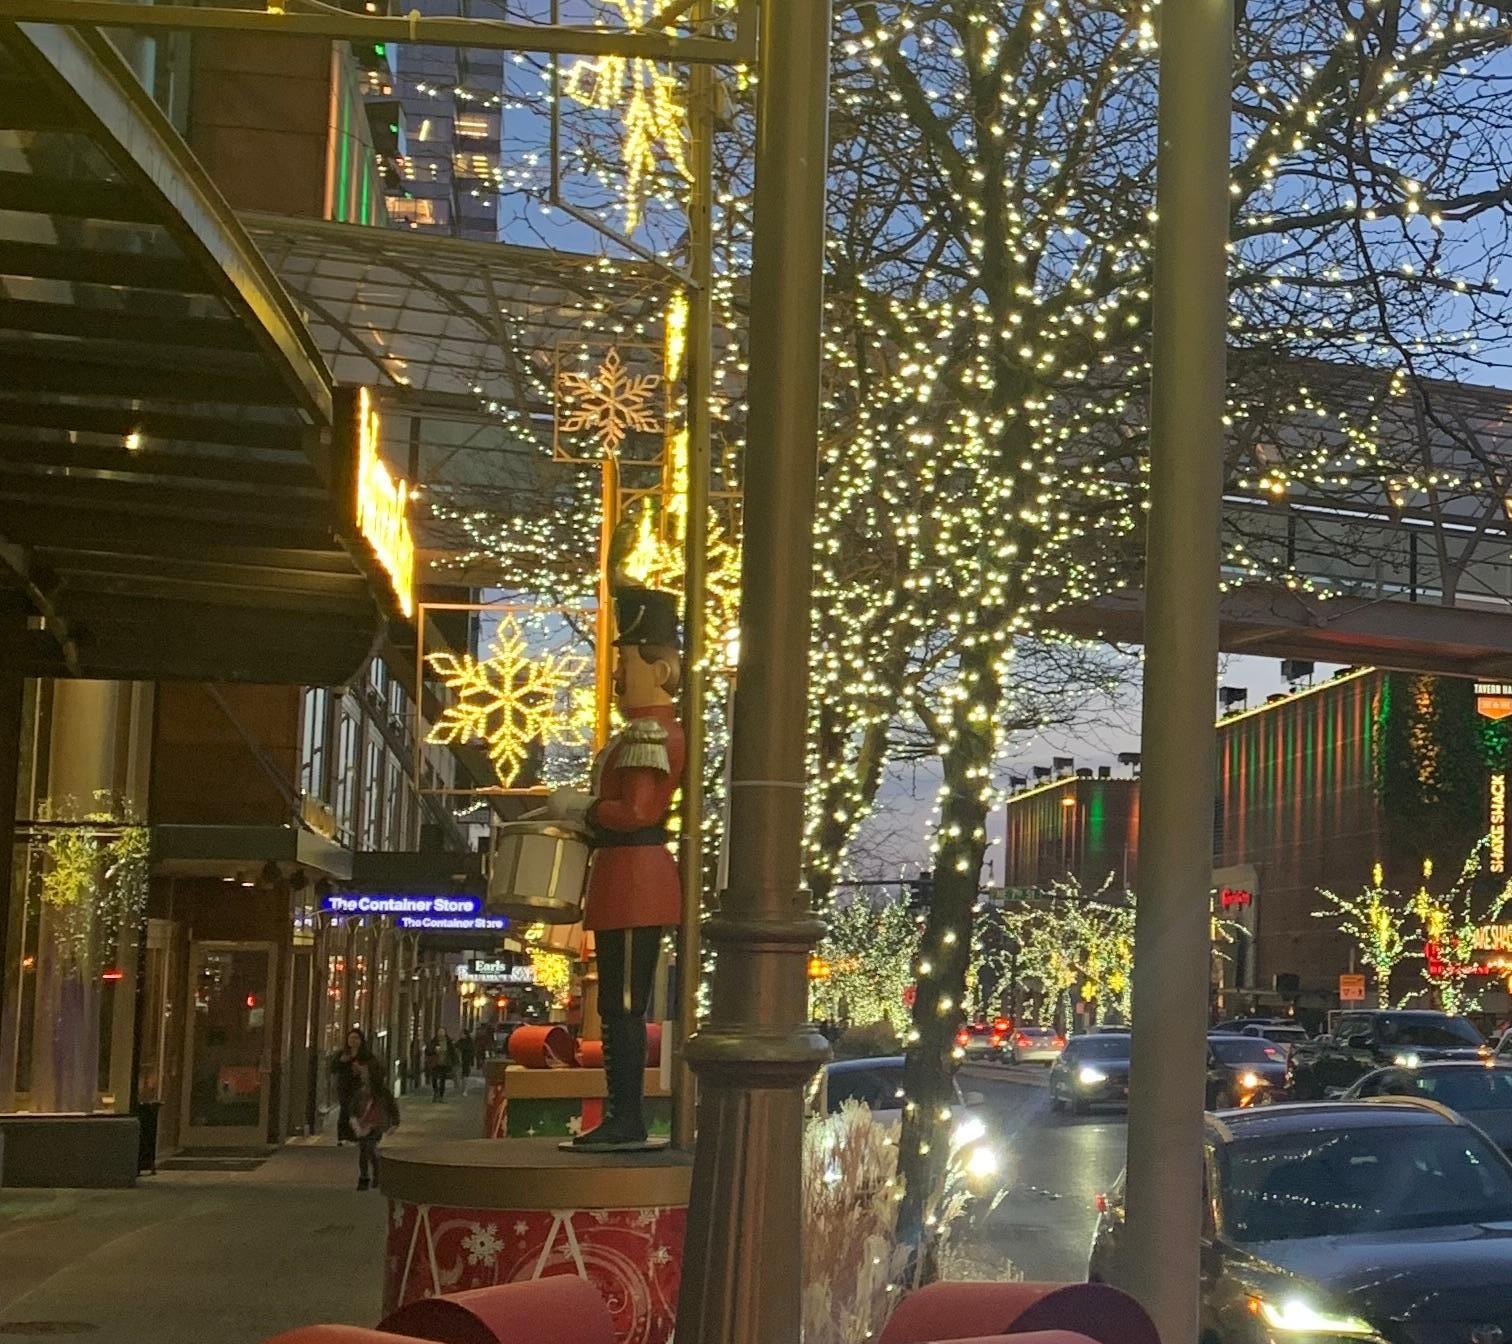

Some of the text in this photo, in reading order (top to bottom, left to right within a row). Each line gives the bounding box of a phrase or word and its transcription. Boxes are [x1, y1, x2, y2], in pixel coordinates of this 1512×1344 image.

[1474, 683, 1501, 694] TAVERN
[1490, 774, 1505, 873] SHAKE SHACK
[328, 896, 474, 912] The Container Store
[402, 917, 503, 929] The Container Store
[475, 959, 506, 972] Earls
